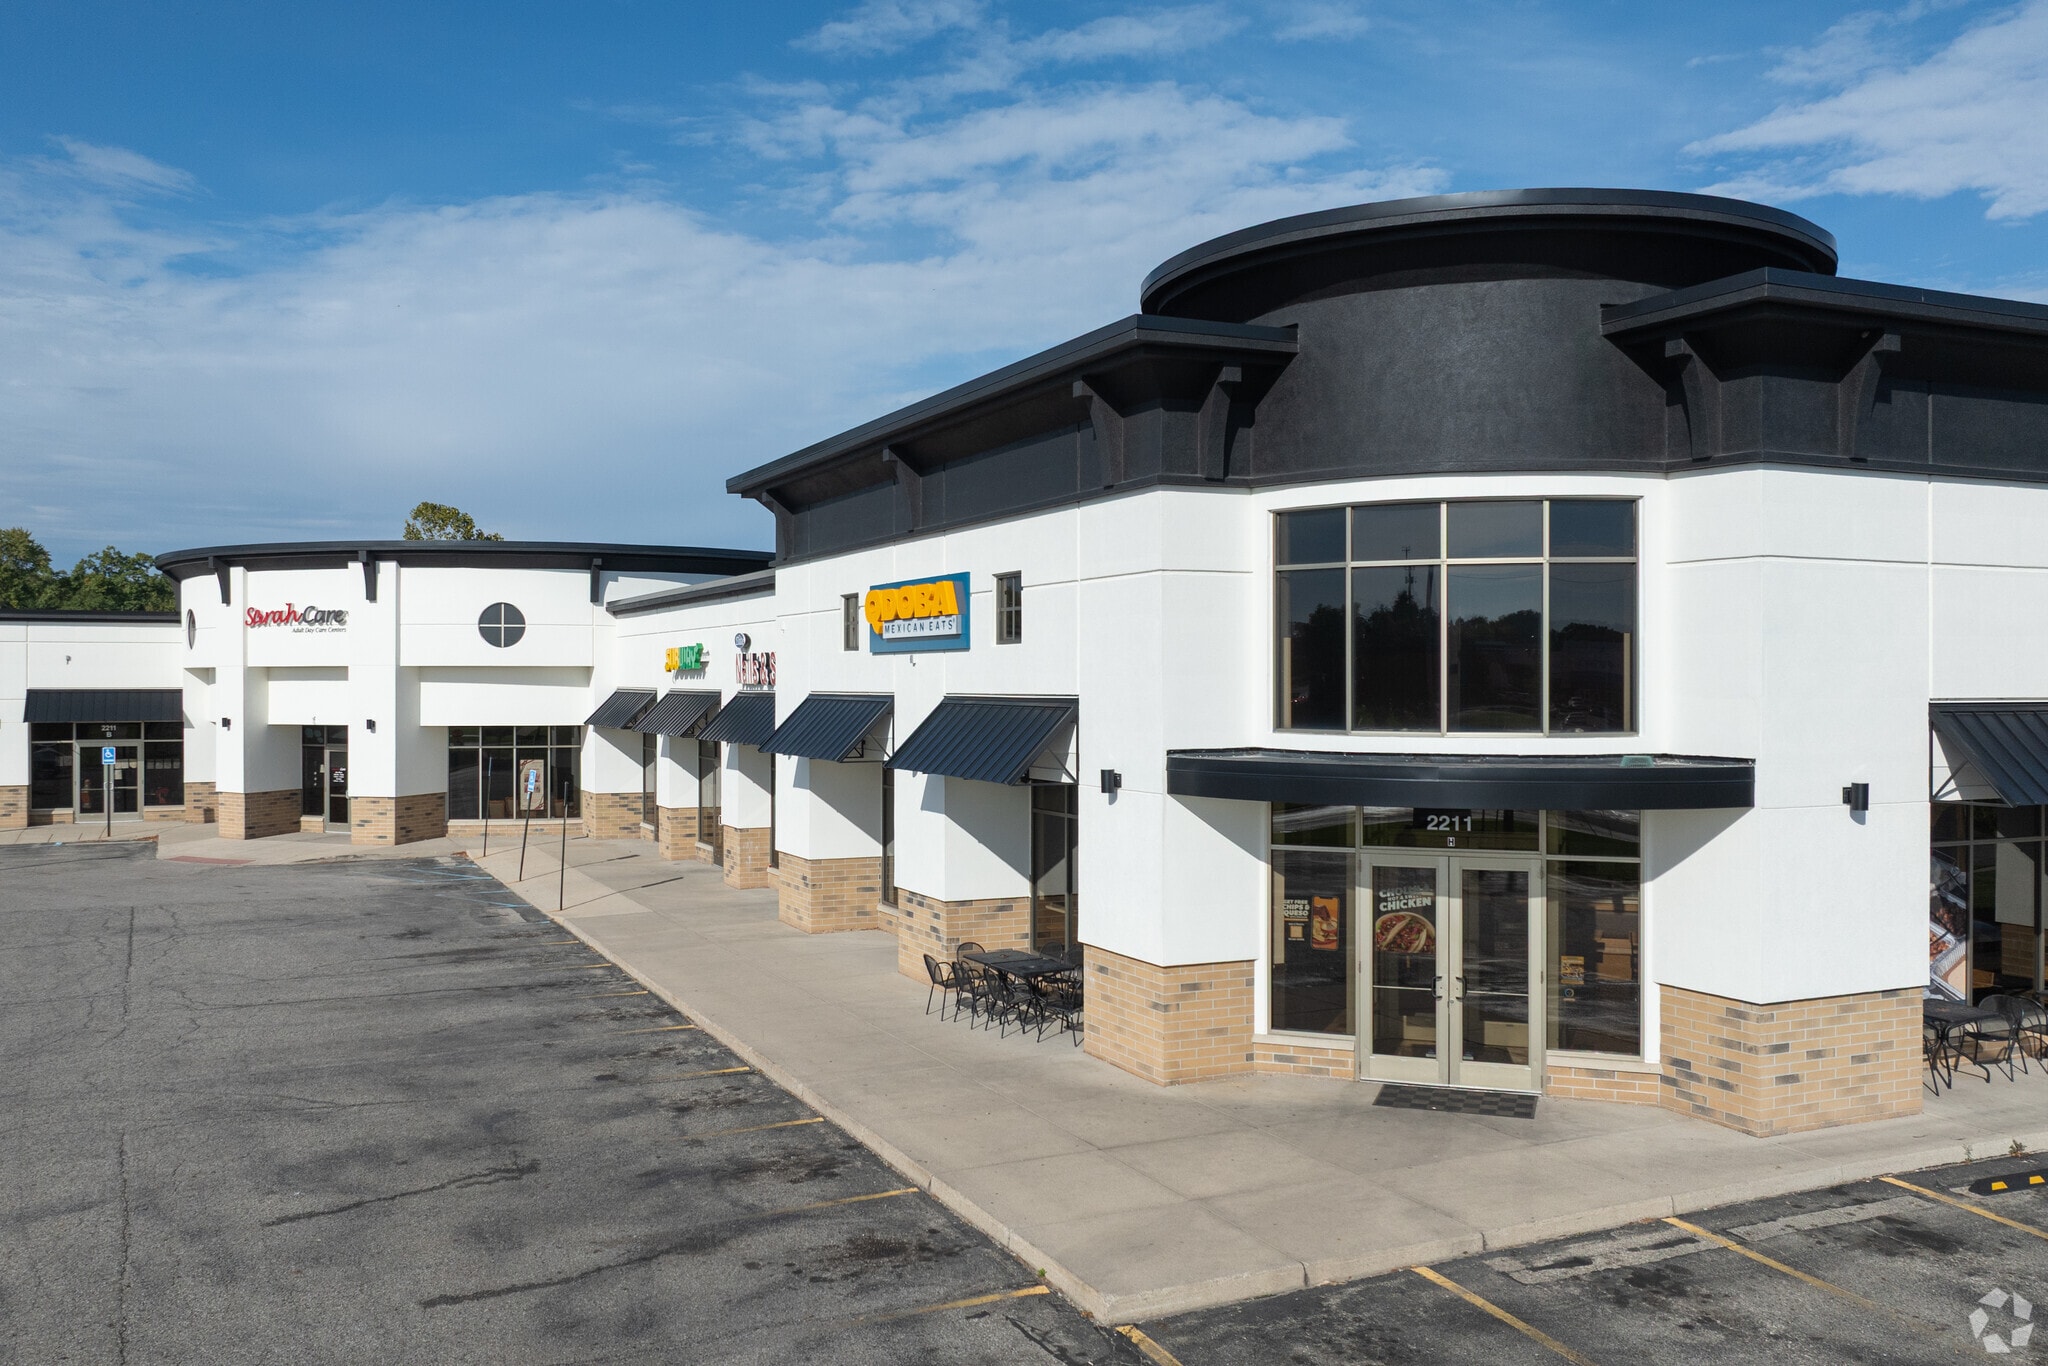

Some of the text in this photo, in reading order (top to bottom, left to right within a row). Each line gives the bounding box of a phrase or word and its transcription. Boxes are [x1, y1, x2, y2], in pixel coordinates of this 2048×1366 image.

[865, 580, 960, 635] QDOBA
[884, 620, 953, 634] MEXICAN EATS
[736, 652, 759, 686] Nails
[760, 652, 769, 686] &
[1426, 814, 1472, 832] 2211
[1447, 837, 1456, 847] H
[1379, 897, 1432, 911] CHICKEN
[1284, 910, 1309, 918] QUESO
